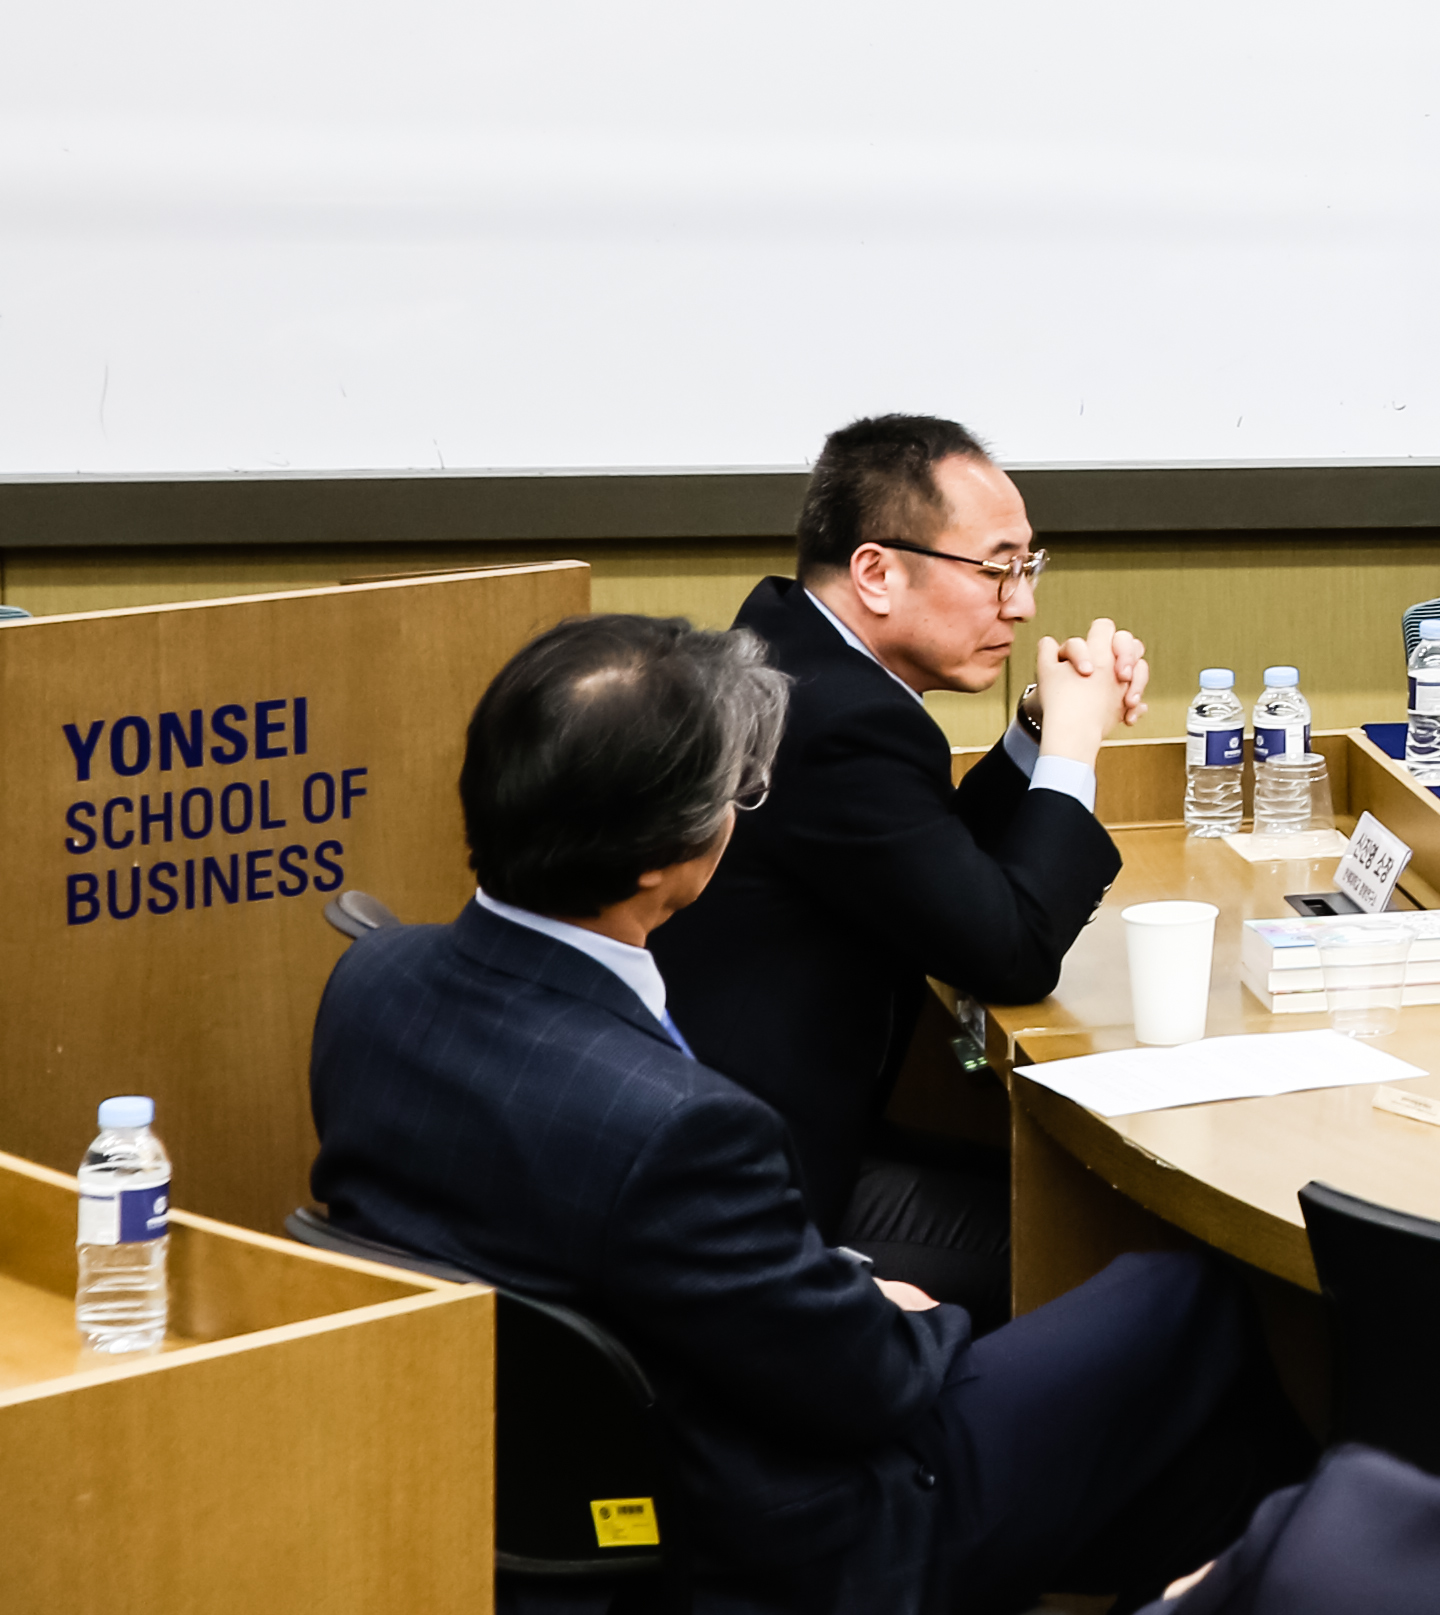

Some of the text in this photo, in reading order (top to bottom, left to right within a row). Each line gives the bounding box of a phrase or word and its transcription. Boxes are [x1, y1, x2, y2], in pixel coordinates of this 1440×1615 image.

[62, 696, 307, 782] YONSEI
[65, 767, 369, 855] SCHOOL OF
[66, 840, 345, 926] BUSINESS
